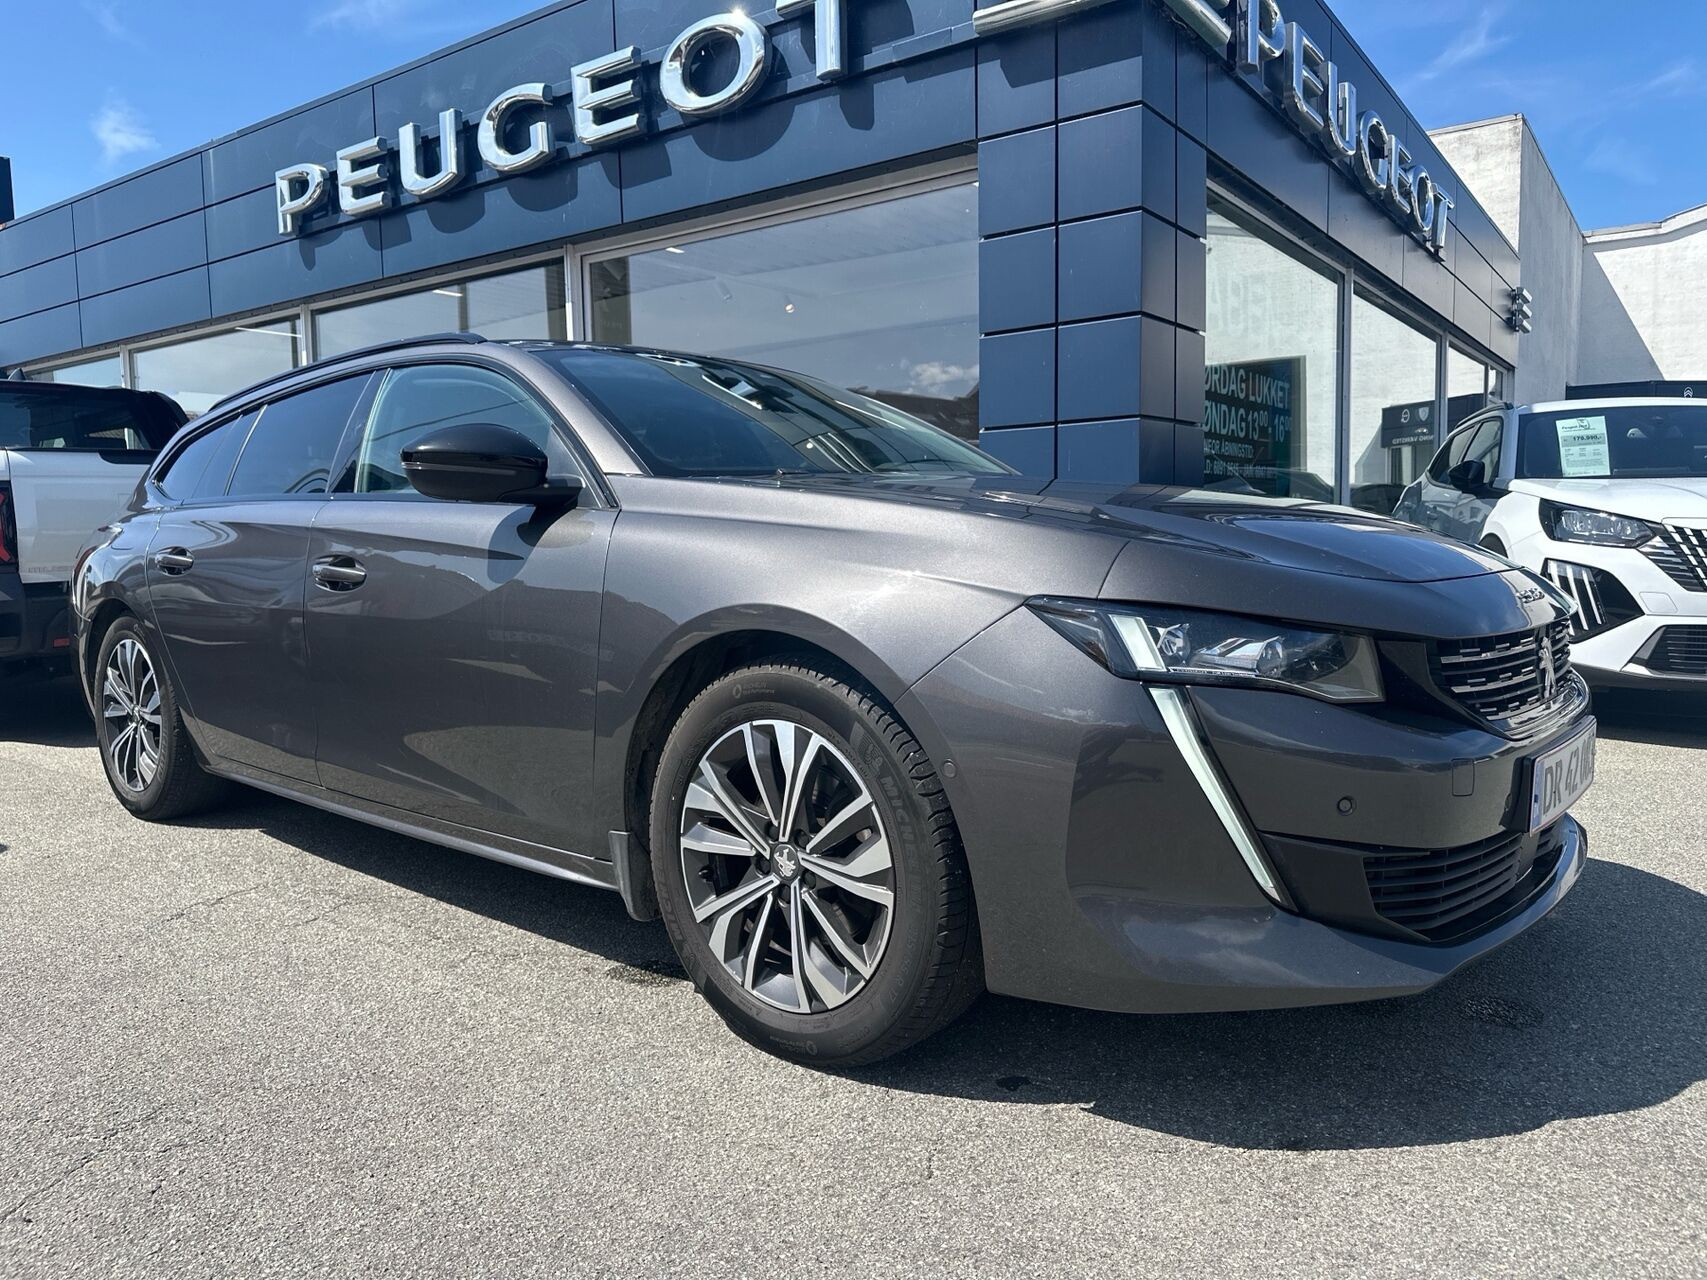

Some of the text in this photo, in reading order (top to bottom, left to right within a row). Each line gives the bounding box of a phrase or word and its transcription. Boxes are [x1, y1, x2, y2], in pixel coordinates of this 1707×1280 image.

[275, 0, 848, 238] PEUGEOT
[1235, 0, 1455, 252] PEUGEOT
[1249, 371, 1291, 410] LUKKET
[1544, 759, 1562, 815] DR
[1565, 746, 1580, 797] 42
